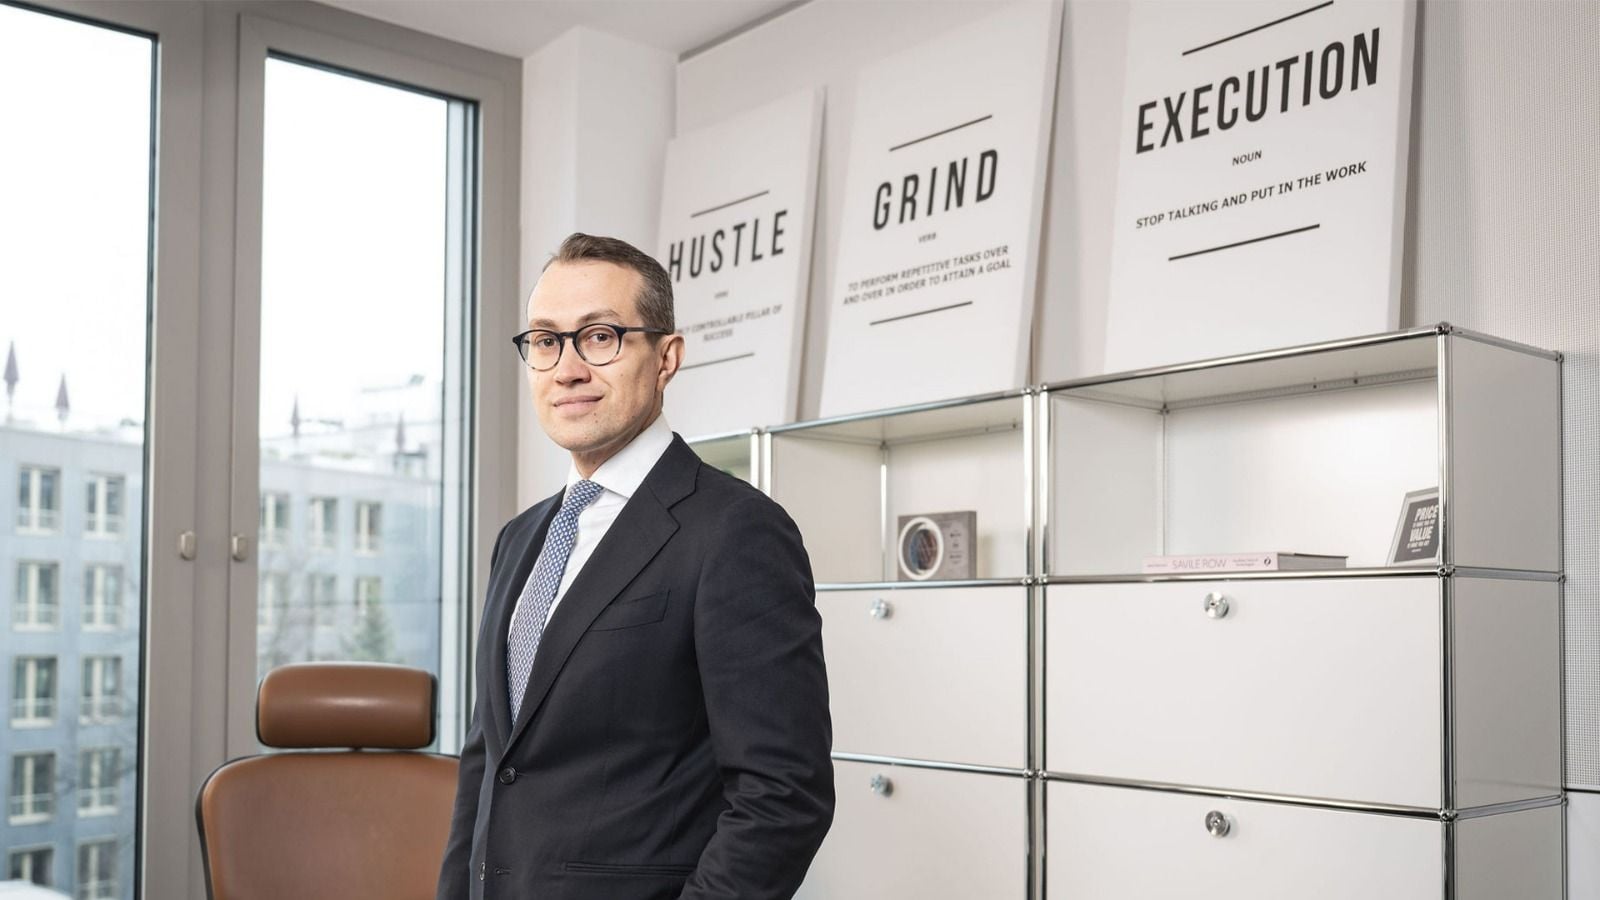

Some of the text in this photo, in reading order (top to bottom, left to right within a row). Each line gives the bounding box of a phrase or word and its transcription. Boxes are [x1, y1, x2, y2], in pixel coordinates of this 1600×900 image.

[1136, 27, 1380, 154] EXECUTION
[1232, 150, 1263, 166] NOUN
[873, 149, 998, 231] GRIND
[1136, 160, 1368, 229] STOP TALKING AND PUT IN THE WORK
[669, 209, 788, 283] HUSTLE
[918, 232, 937, 244] VERB
[843, 259, 1012, 305] AND OVER IN ORDER TO ATTAIN A GOAL
[848, 245, 1009, 292] TO PERFORM REPETITIVE TASKS OVER
[1410, 526, 1433, 542] VALUE
[1415, 505, 1438, 521] PRICE
[1171, 558, 1201, 570] SAVILE
[1203, 557, 1228, 569] ROW
